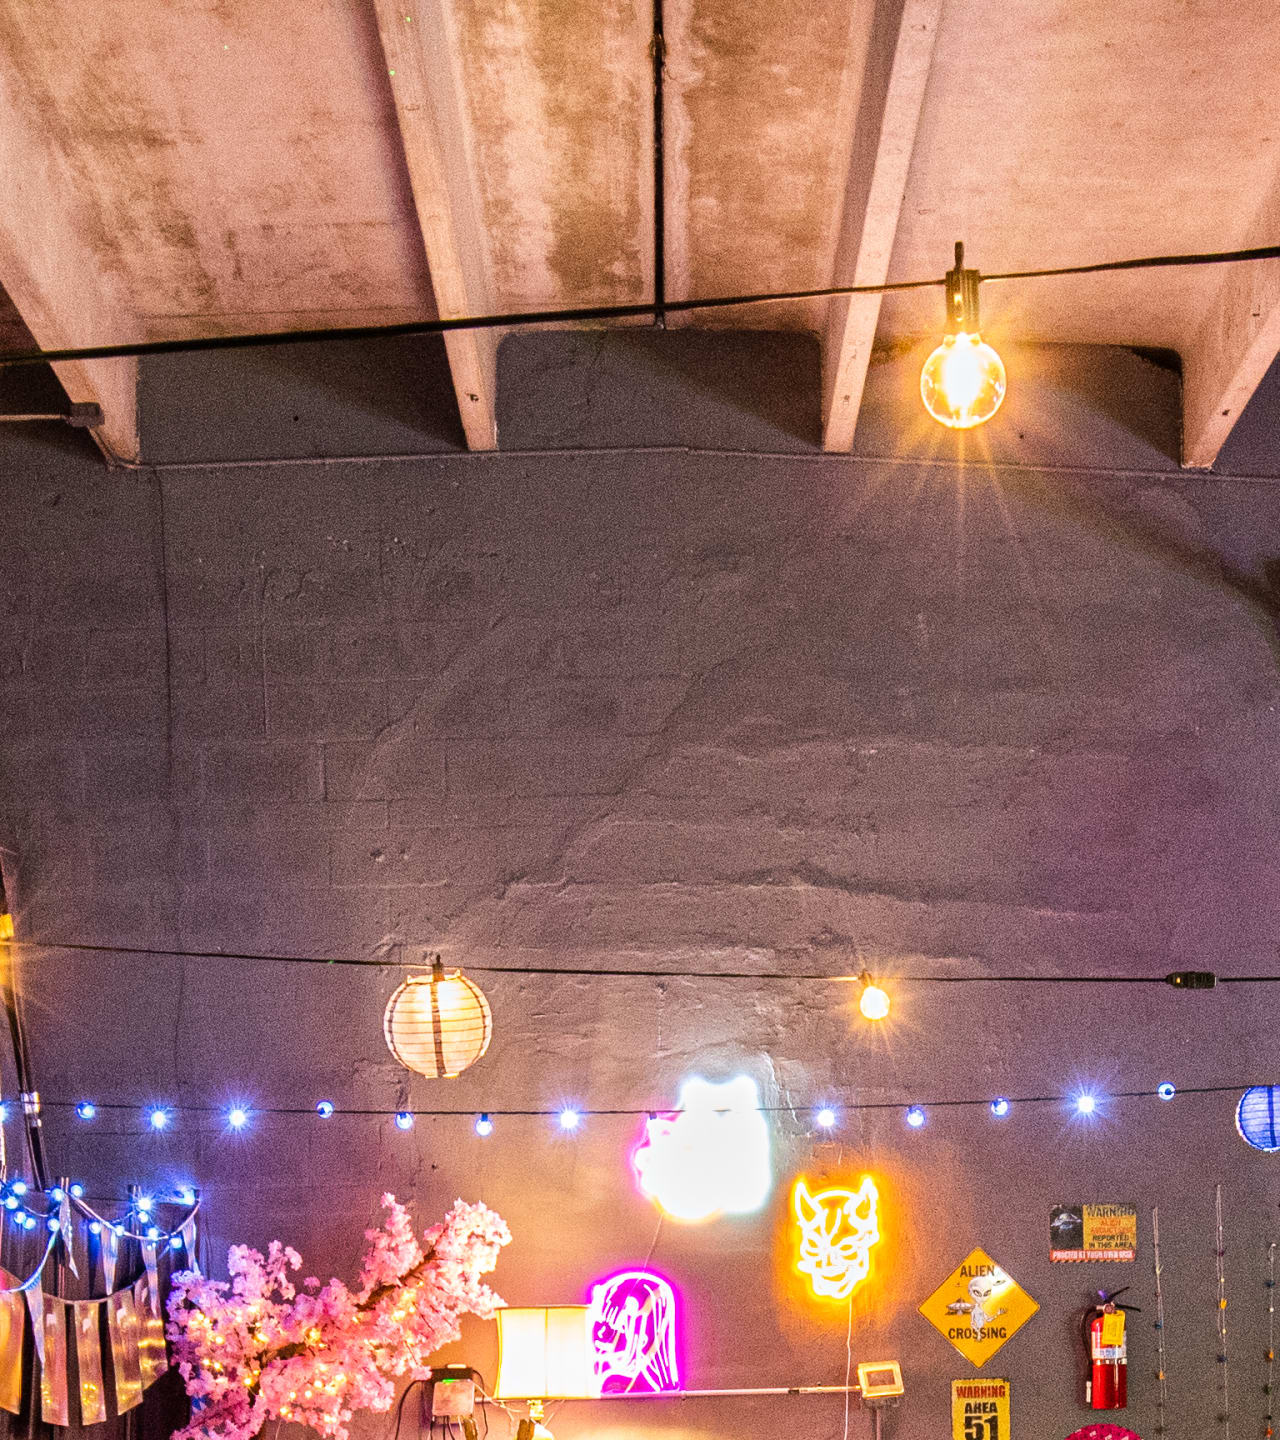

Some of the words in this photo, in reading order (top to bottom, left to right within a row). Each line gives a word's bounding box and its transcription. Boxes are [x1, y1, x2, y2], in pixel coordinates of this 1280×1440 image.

[960, 1265, 995, 1278] ALIEN
[948, 1328, 1007, 1340] CROSSING
[956, 1385, 1006, 1398] WARNING
[965, 1401, 998, 1414] AREA
